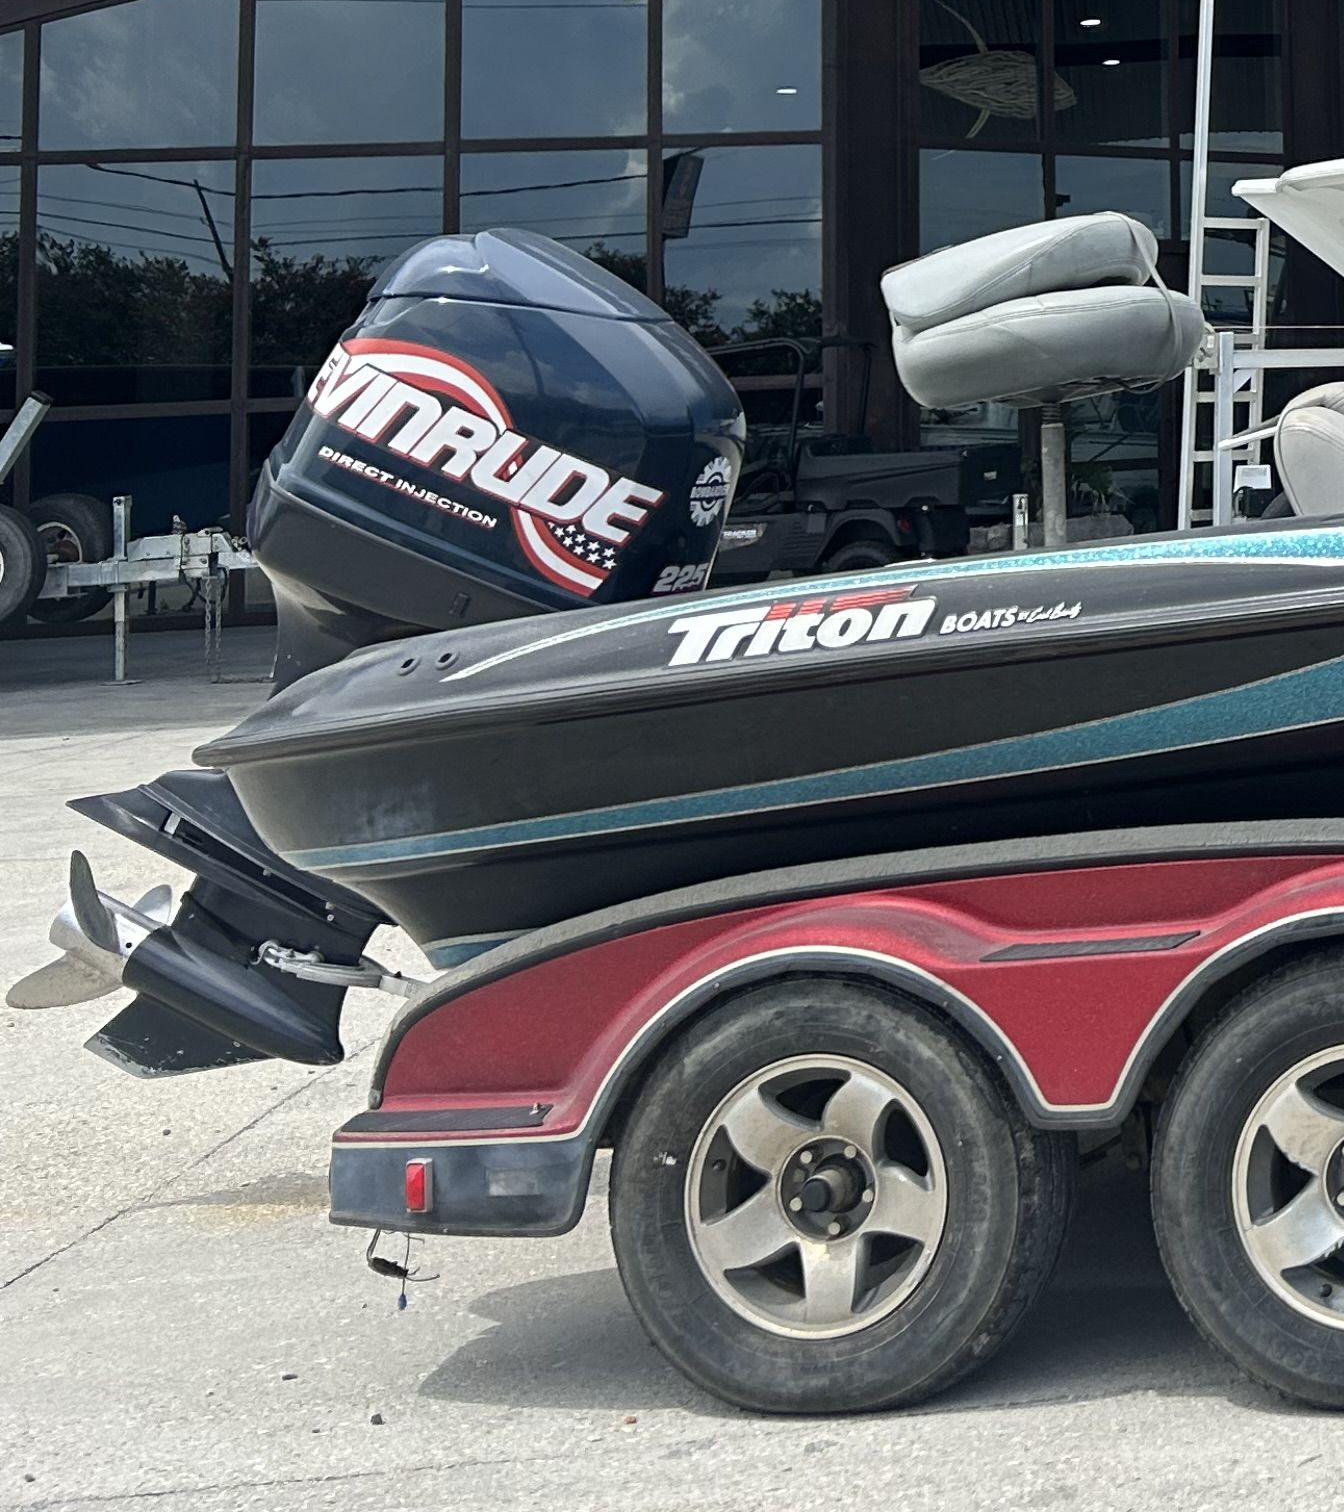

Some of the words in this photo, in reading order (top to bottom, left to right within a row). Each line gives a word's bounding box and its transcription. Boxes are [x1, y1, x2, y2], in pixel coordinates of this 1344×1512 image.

[317, 445, 393, 486] DIRECT
[396, 477, 498, 530] INJECTION
[653, 562, 709, 593] 225
[667, 585, 938, 667] Triton
[939, 605, 1019, 635] BOATS
